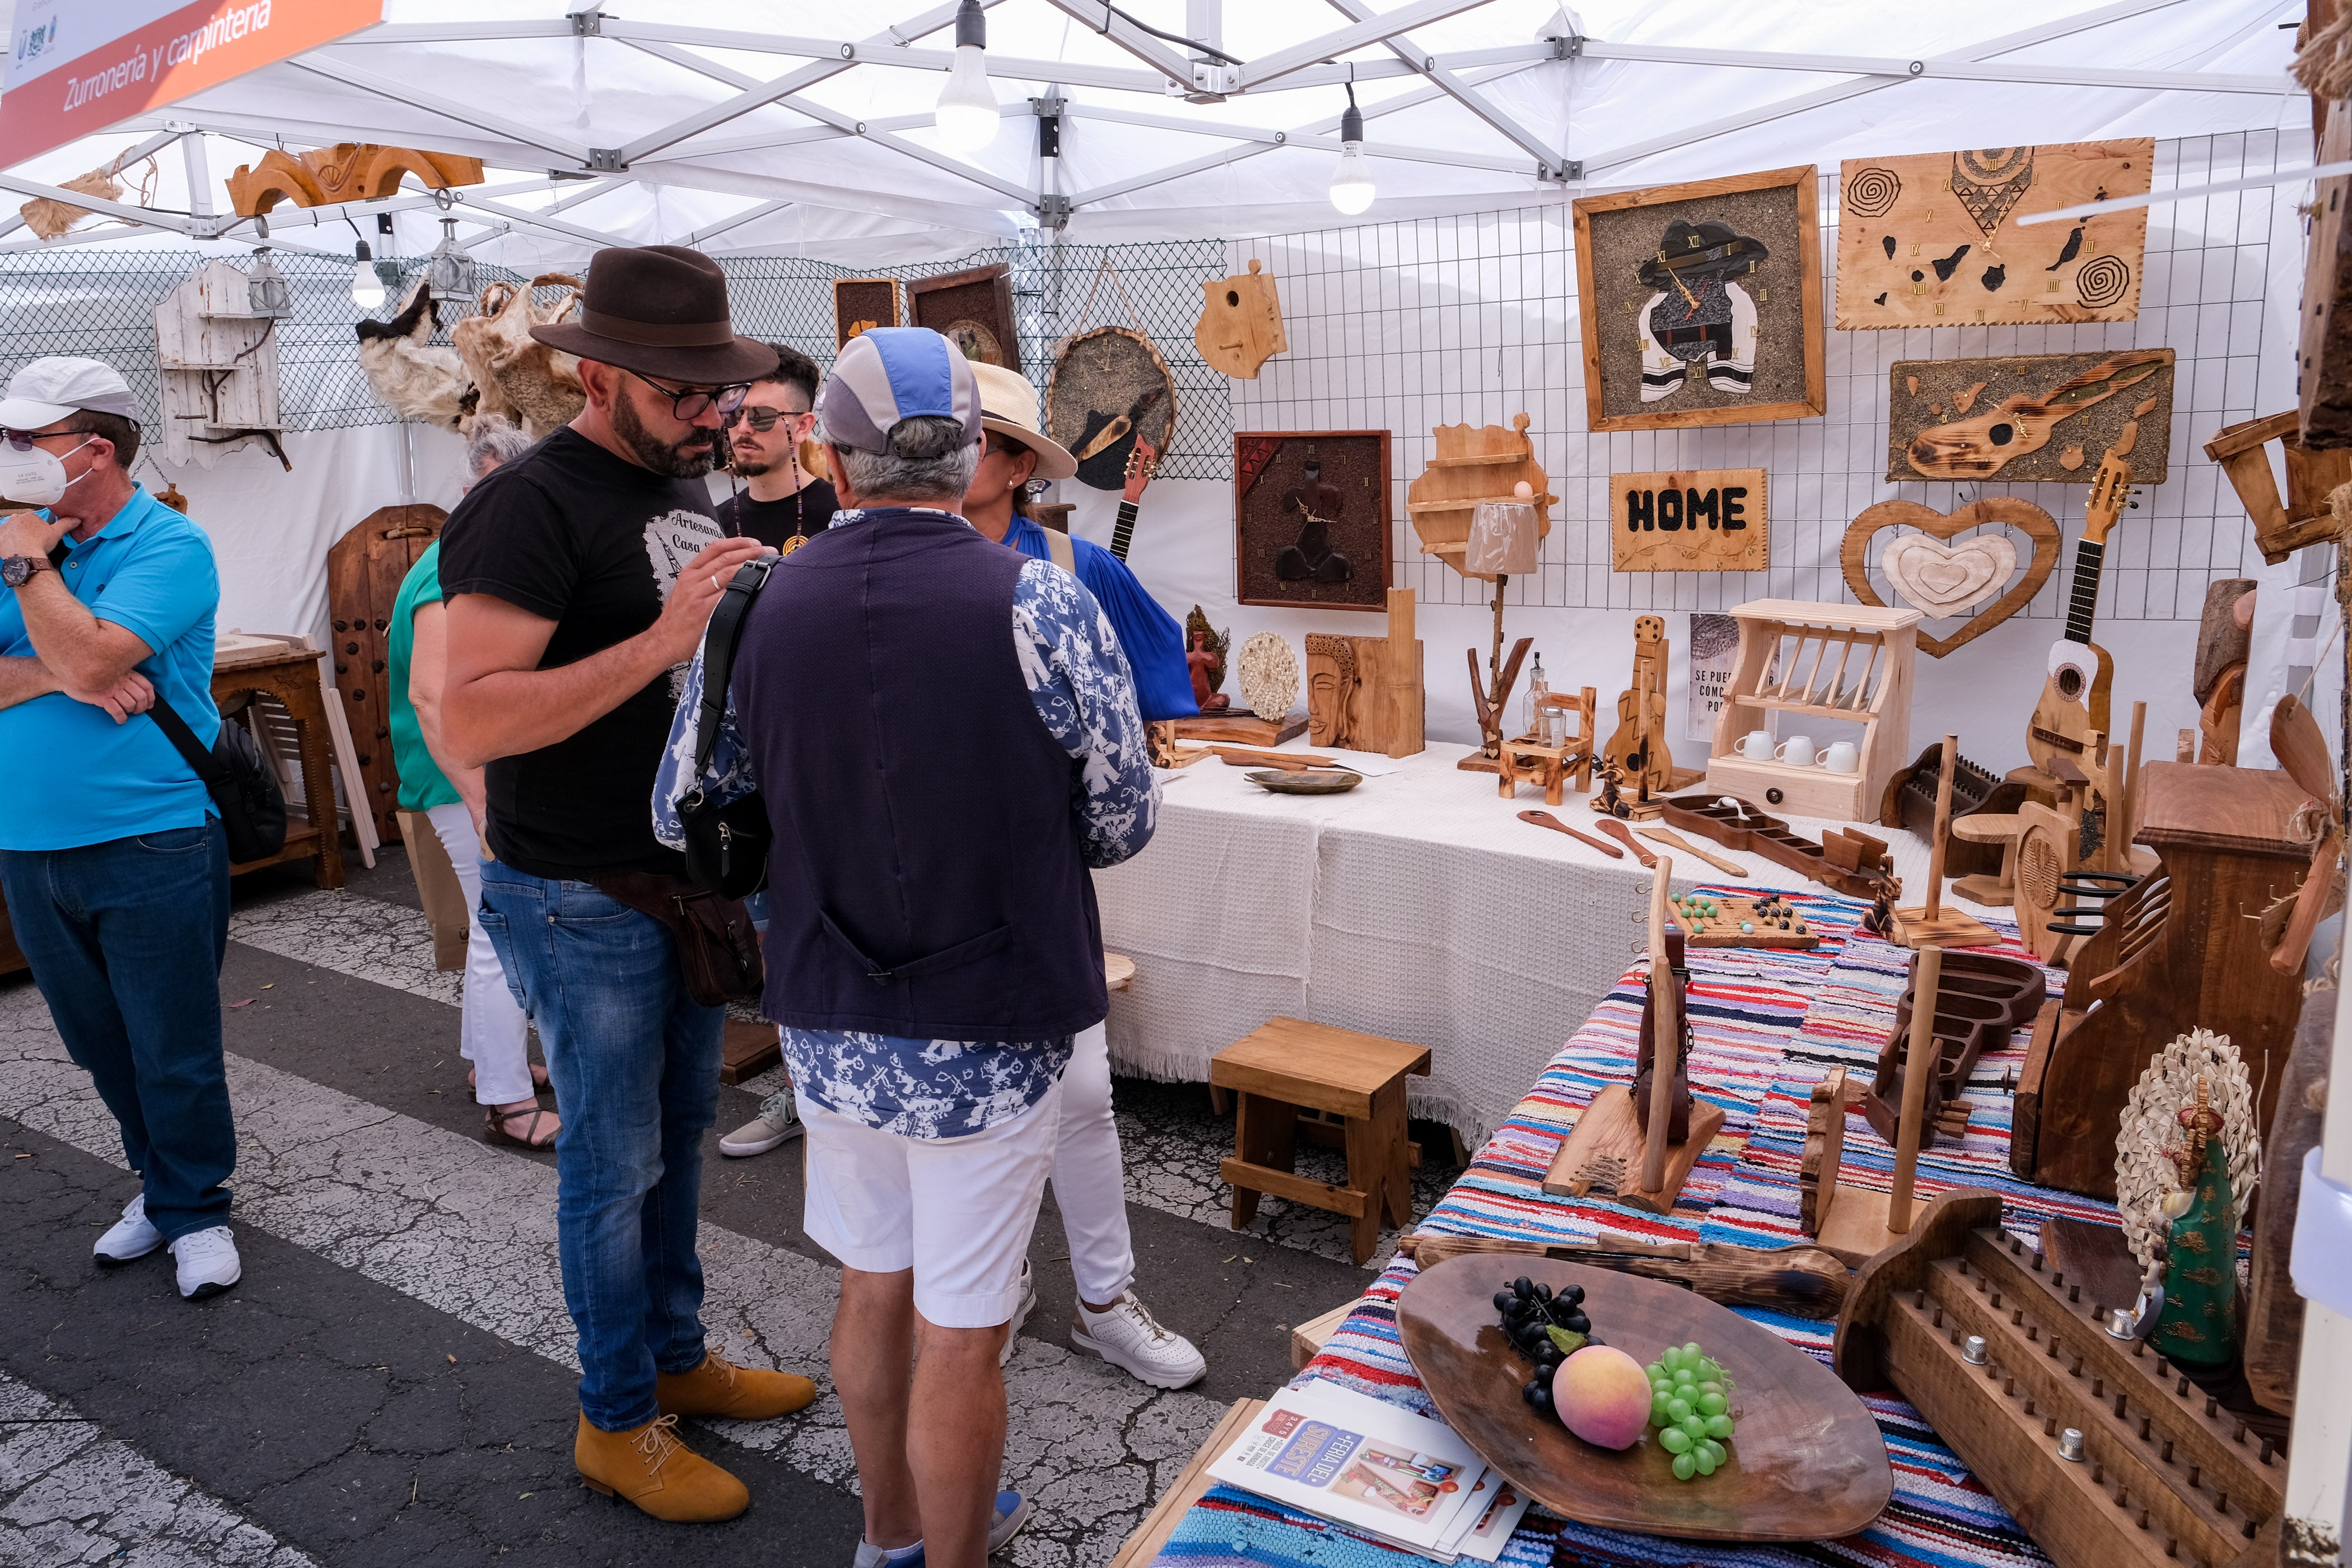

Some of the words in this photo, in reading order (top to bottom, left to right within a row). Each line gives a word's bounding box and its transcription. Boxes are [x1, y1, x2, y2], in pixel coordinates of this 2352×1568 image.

[63, 44, 147, 111] Zurronería
[150, 45, 164, 82] y
[1985, 159, 1998, 171] XII
[1942, 179, 1952, 191] XI
[2034, 172, 2039, 185] I
[1926, 210, 1933, 222] X
[1688, 235, 1700, 248] XII
[2084, 240, 2094, 253] III
[1726, 244, 1732, 256] I
[1911, 244, 1920, 256] IX
[1656, 250, 1666, 264] XI
[1749, 260, 1756, 273] II
[1634, 272, 1641, 284] X
[1912, 283, 1926, 295] VIII
[2047, 279, 2060, 292] IIII
[1933, 303, 1944, 315] VII
[2021, 300, 2028, 312] V
[1975, 310, 1985, 321] VI
[1636, 339, 1650, 351] VIII
[1732, 347, 1739, 360] V
[1659, 357, 1670, 368] VII
[1693, 366, 1702, 379] VI
[1628, 487, 1747, 533] HOME
[673, 534, 700, 553] Casa
[1696, 670, 1706, 682] SE
[1273, 1425, 1331, 1476] SURESTE
[1320, 1437, 1354, 1464] FERIA
[1306, 1463, 1334, 1480] DEL
